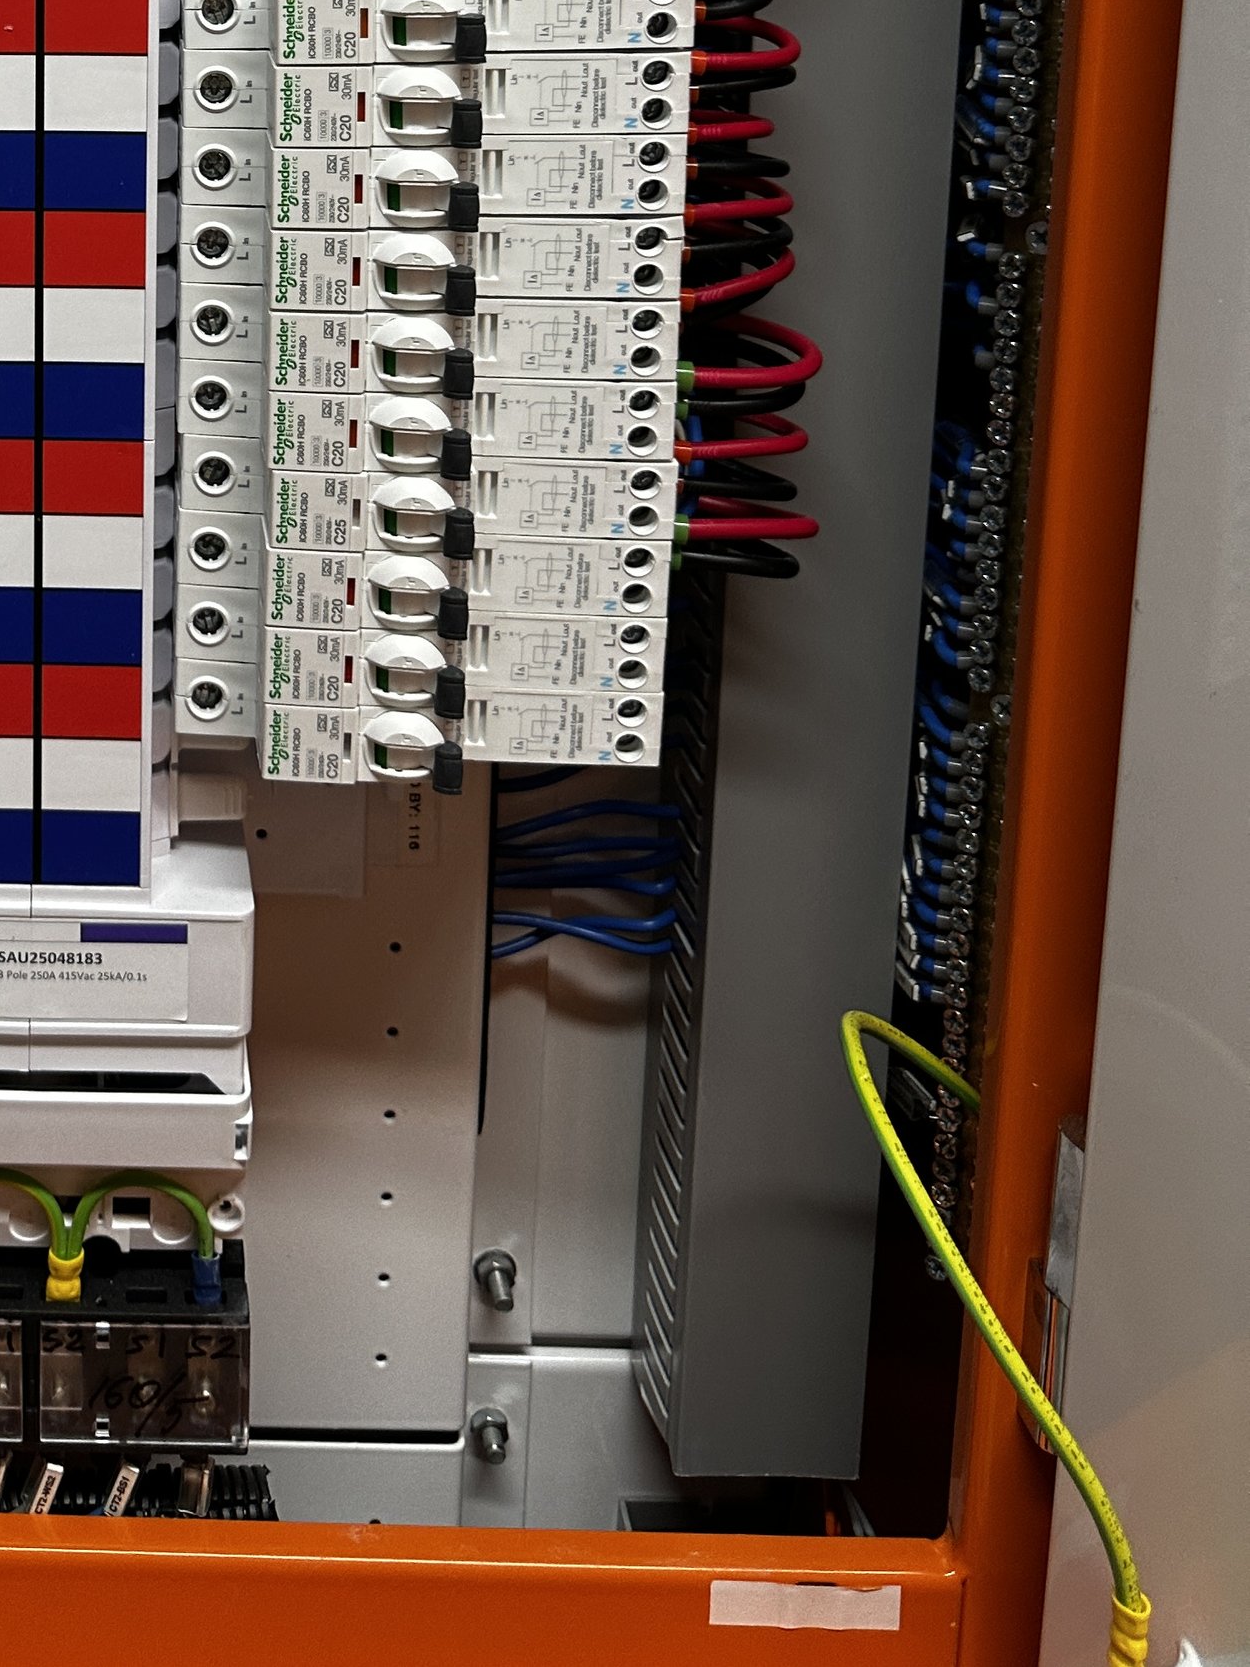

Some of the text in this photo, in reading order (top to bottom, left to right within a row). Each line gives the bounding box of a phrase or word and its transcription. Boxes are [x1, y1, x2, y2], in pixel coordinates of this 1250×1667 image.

[344, 32, 356, 58] C20
[280, 73, 293, 141] Schneider
[339, 115, 351, 141] C20
[278, 155, 290, 222] Schneider
[337, 156, 349, 223] C20 30mA
[275, 237, 288, 303] Schneider
[334, 279, 347, 305] C20
[276, 319, 288, 385] Schneider
[334, 362, 346, 387] C20
[273, 399, 286, 464] Schneider
[332, 441, 344, 466] C20
[276, 478, 288, 543] Schneider
[334, 520, 346, 545] C25
[271, 555, 284, 620] Schneider
[331, 599, 343, 624] C20
[269, 634, 282, 698] Schneider
[327, 676, 339, 701] C20
[268, 710, 281, 774] Schneider
[326, 716, 339, 779] C20 30mA
[7, 970, 27, 981] Pole
[31, 971, 56, 980] 250A
[59, 971, 94, 981] 415Vac
[97, 972, 147, 982] 25kA/0.1s
[185, 1336, 238, 1359] S2
